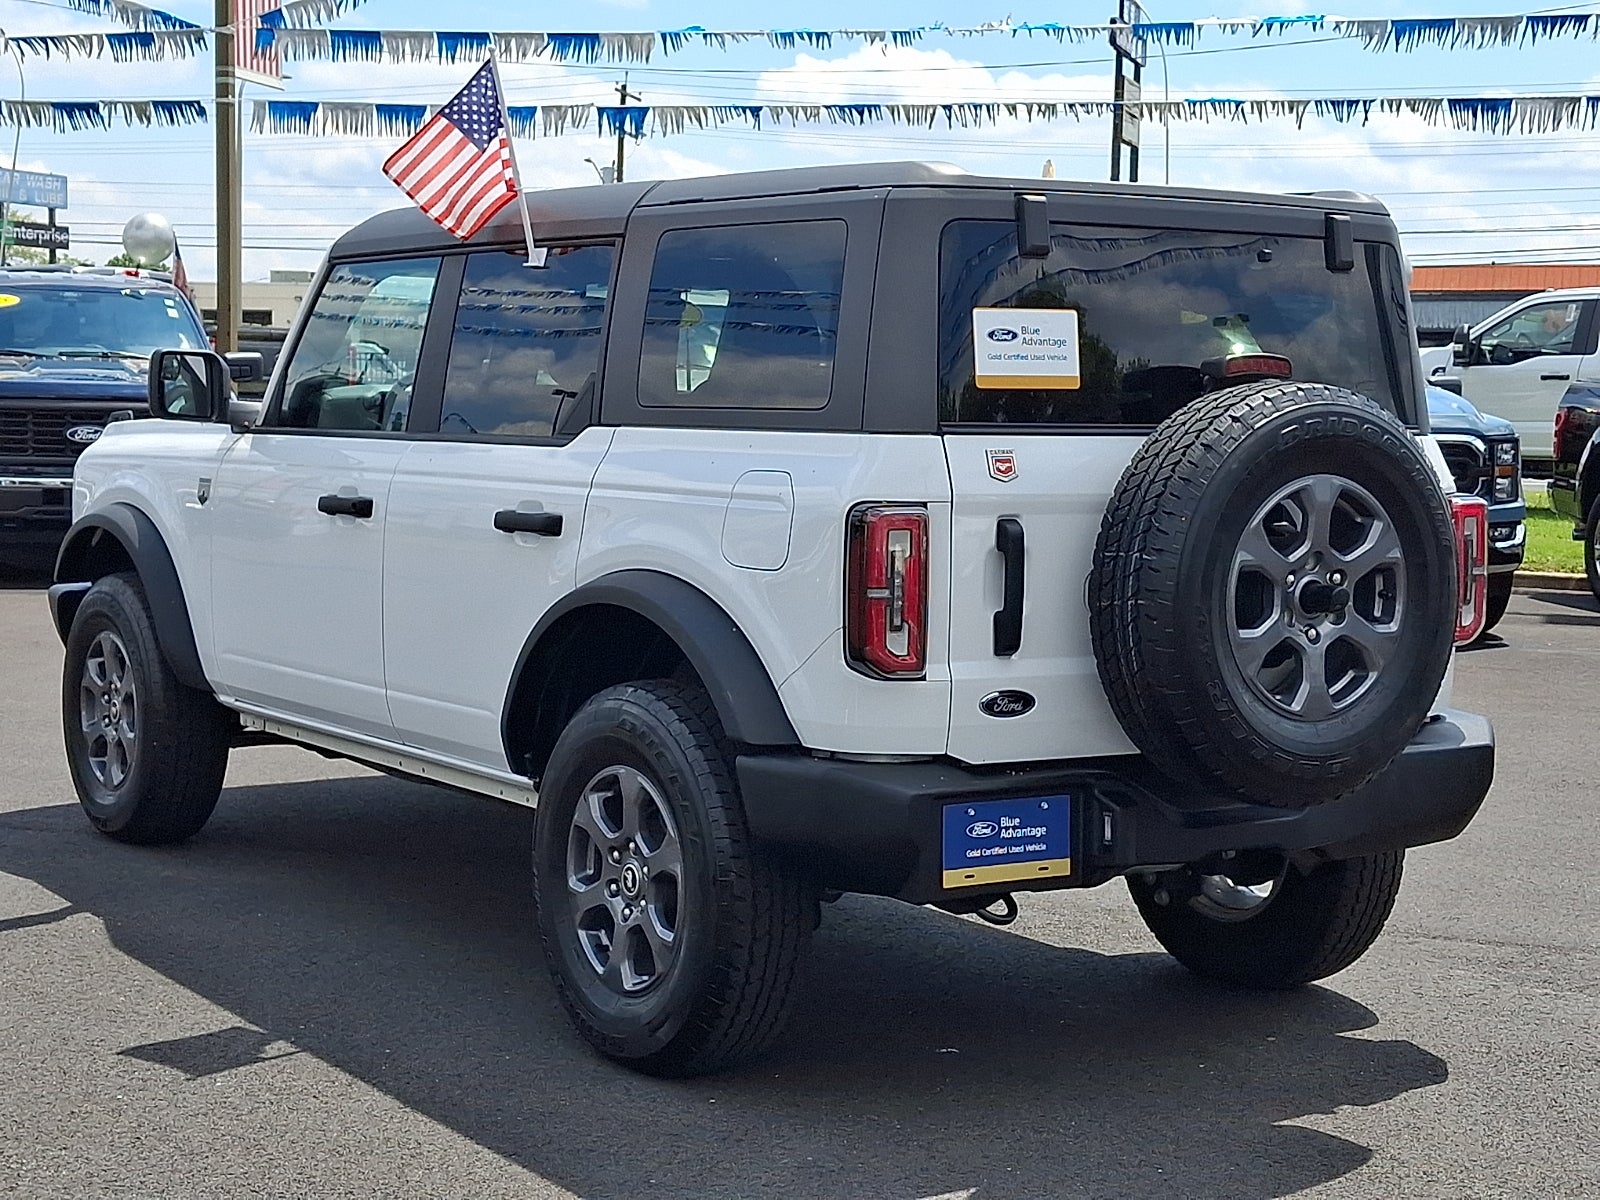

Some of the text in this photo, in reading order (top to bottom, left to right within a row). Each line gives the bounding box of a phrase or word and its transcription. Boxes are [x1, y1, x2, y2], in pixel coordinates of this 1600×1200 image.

[26, 174, 61, 190] WASH
[35, 191, 65, 205] LUBE
[4, 226, 69, 245] enterprise
[992, 330, 1014, 341] Ford
[1021, 326, 1041, 336] Blue
[1021, 337, 1067, 348] Advantage
[987, 353, 1002, 361] Gold
[1003, 353, 1029, 361] Certified
[75, 429, 102, 440] Ford
[993, 696, 1024, 712] Ford
[1000, 816, 1021, 828] Blue
[971, 823, 993, 835] Ford
[1000, 826, 1047, 839] Advantage
[966, 842, 1047, 858] Gold Certified Used Vehicle
